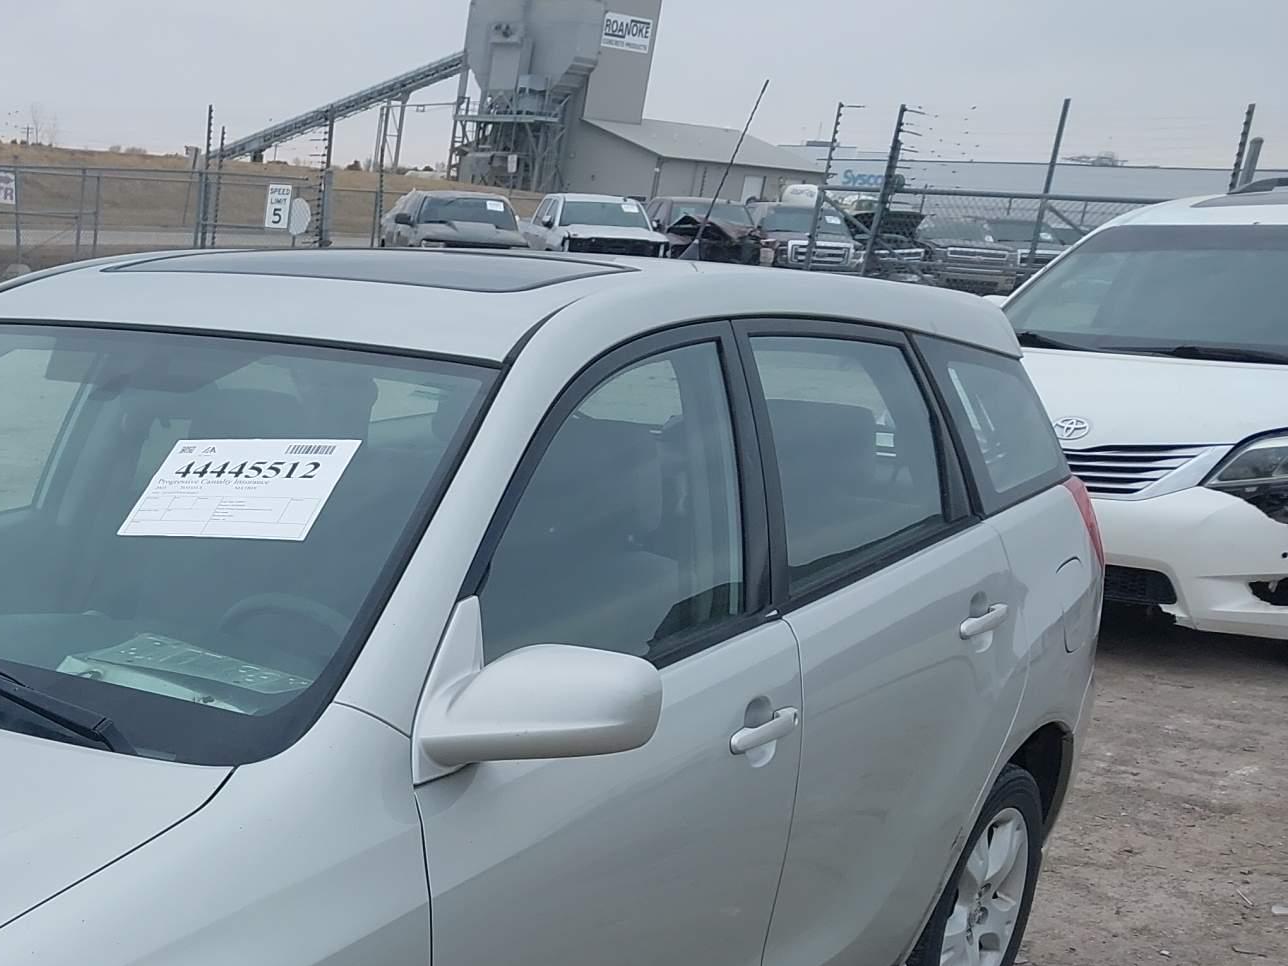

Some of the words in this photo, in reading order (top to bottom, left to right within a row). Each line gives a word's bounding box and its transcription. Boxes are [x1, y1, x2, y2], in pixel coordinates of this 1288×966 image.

[604, 18, 651, 39] ROANOKE
[269, 187, 291, 196] SPEED
[272, 207, 282, 224] 5
[174, 460, 322, 479] 44445512
